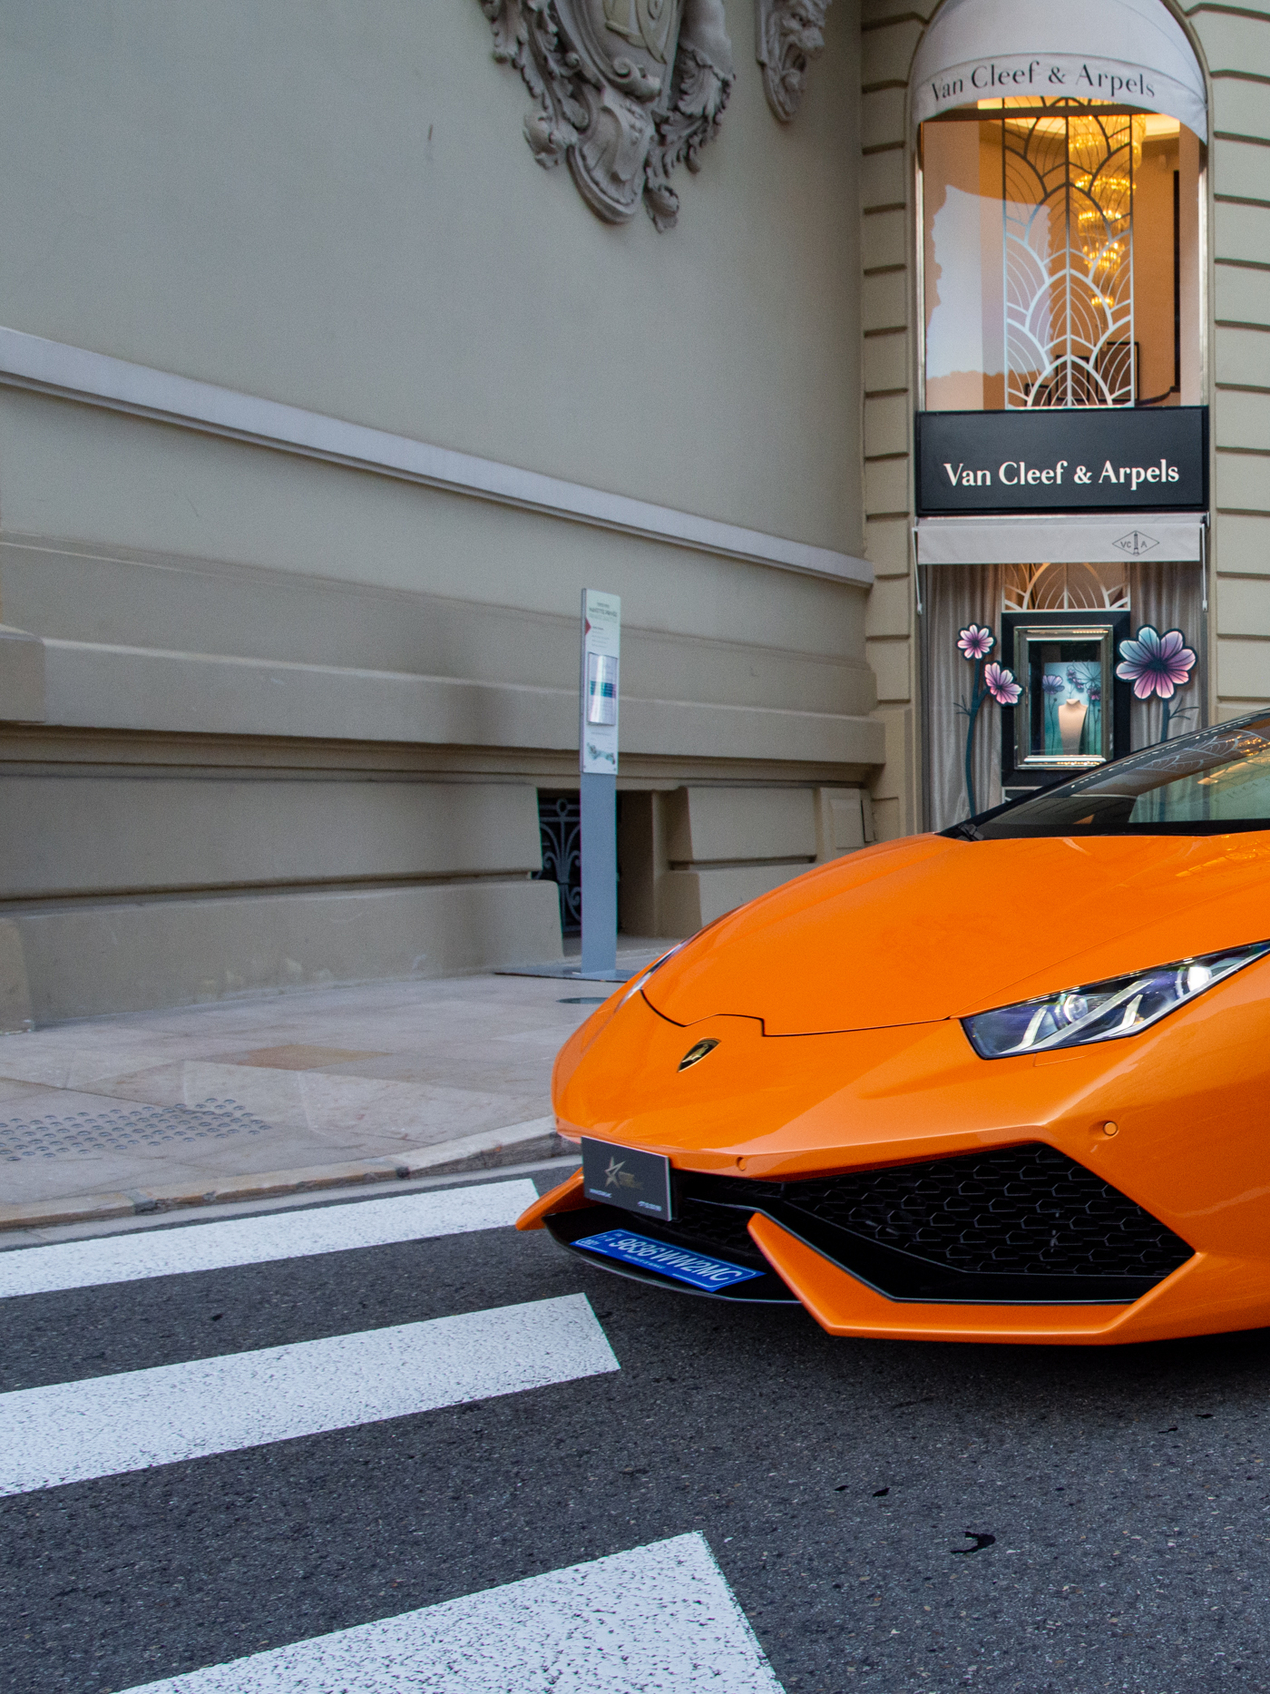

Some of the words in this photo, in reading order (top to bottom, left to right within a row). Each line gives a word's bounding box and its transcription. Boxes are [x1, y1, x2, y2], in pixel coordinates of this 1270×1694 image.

[932, 78, 963, 101] Van
[971, 60, 1040, 89] Cleef
[1048, 65, 1066, 85] &
[1075, 63, 1155, 98] Arpels
[943, 463, 992, 486] Van
[999, 460, 1068, 485] Cleef
[1073, 465, 1092, 484] &
[1098, 459, 1180, 490] Arpels
